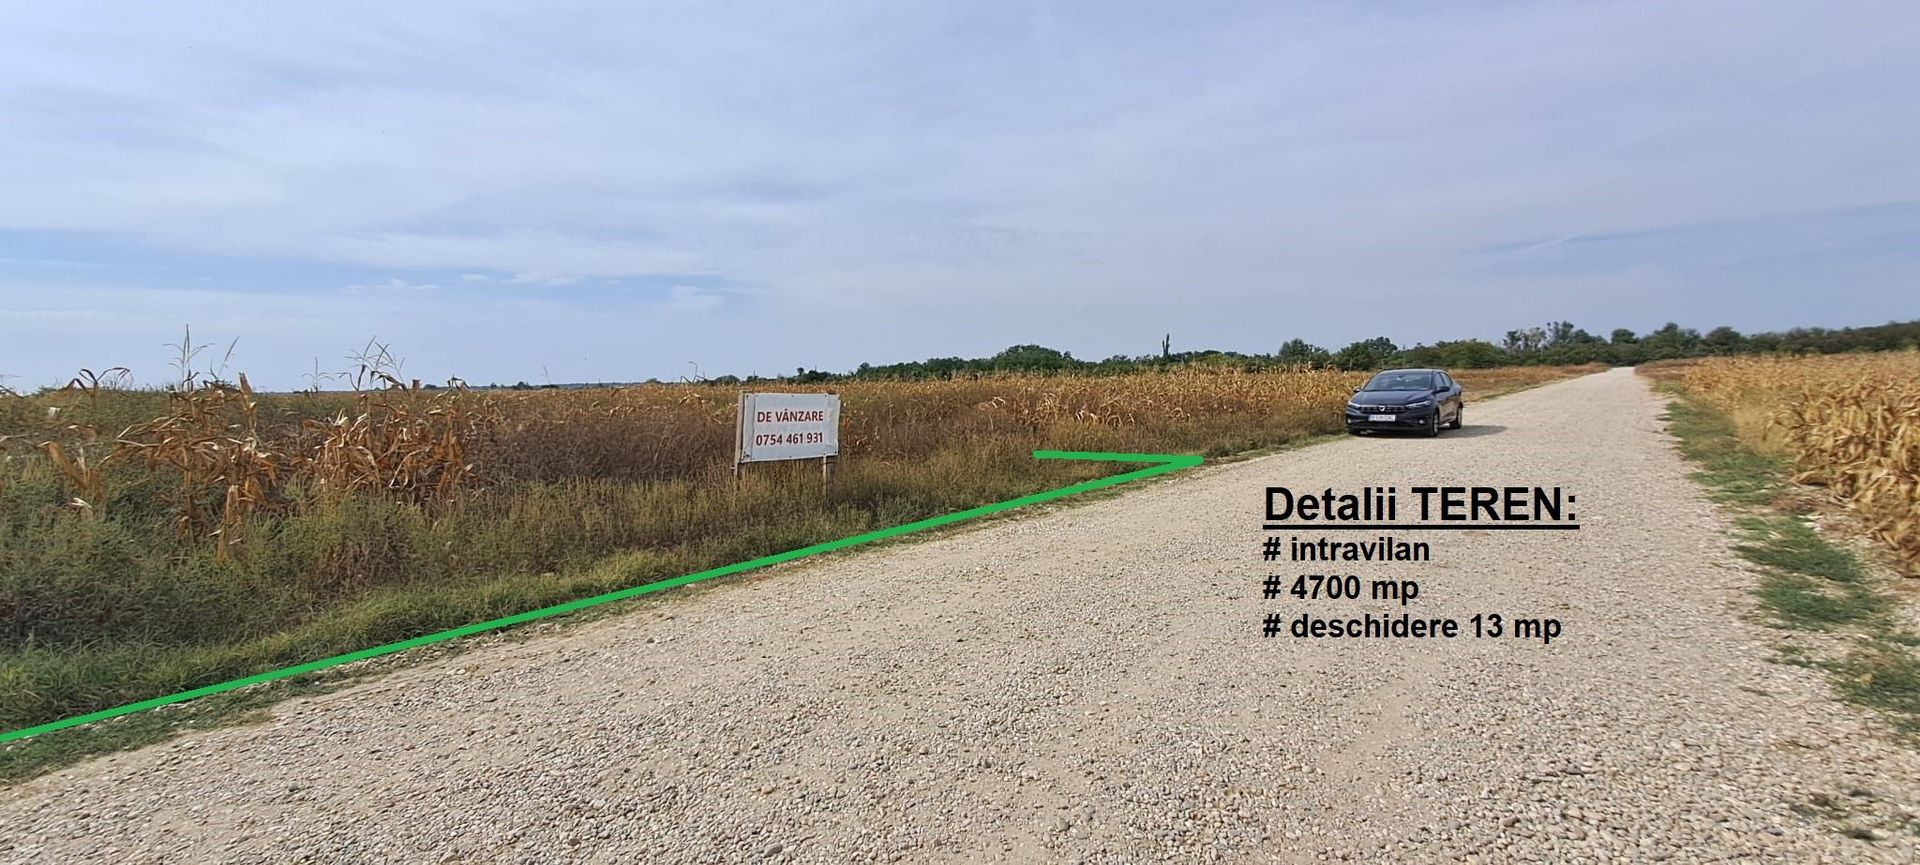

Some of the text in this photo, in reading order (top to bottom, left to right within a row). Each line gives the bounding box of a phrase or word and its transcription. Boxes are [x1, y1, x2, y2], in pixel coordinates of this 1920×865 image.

[757, 408, 824, 423] DE VÂNZARE
[756, 432, 823, 446] 0754 461 931
